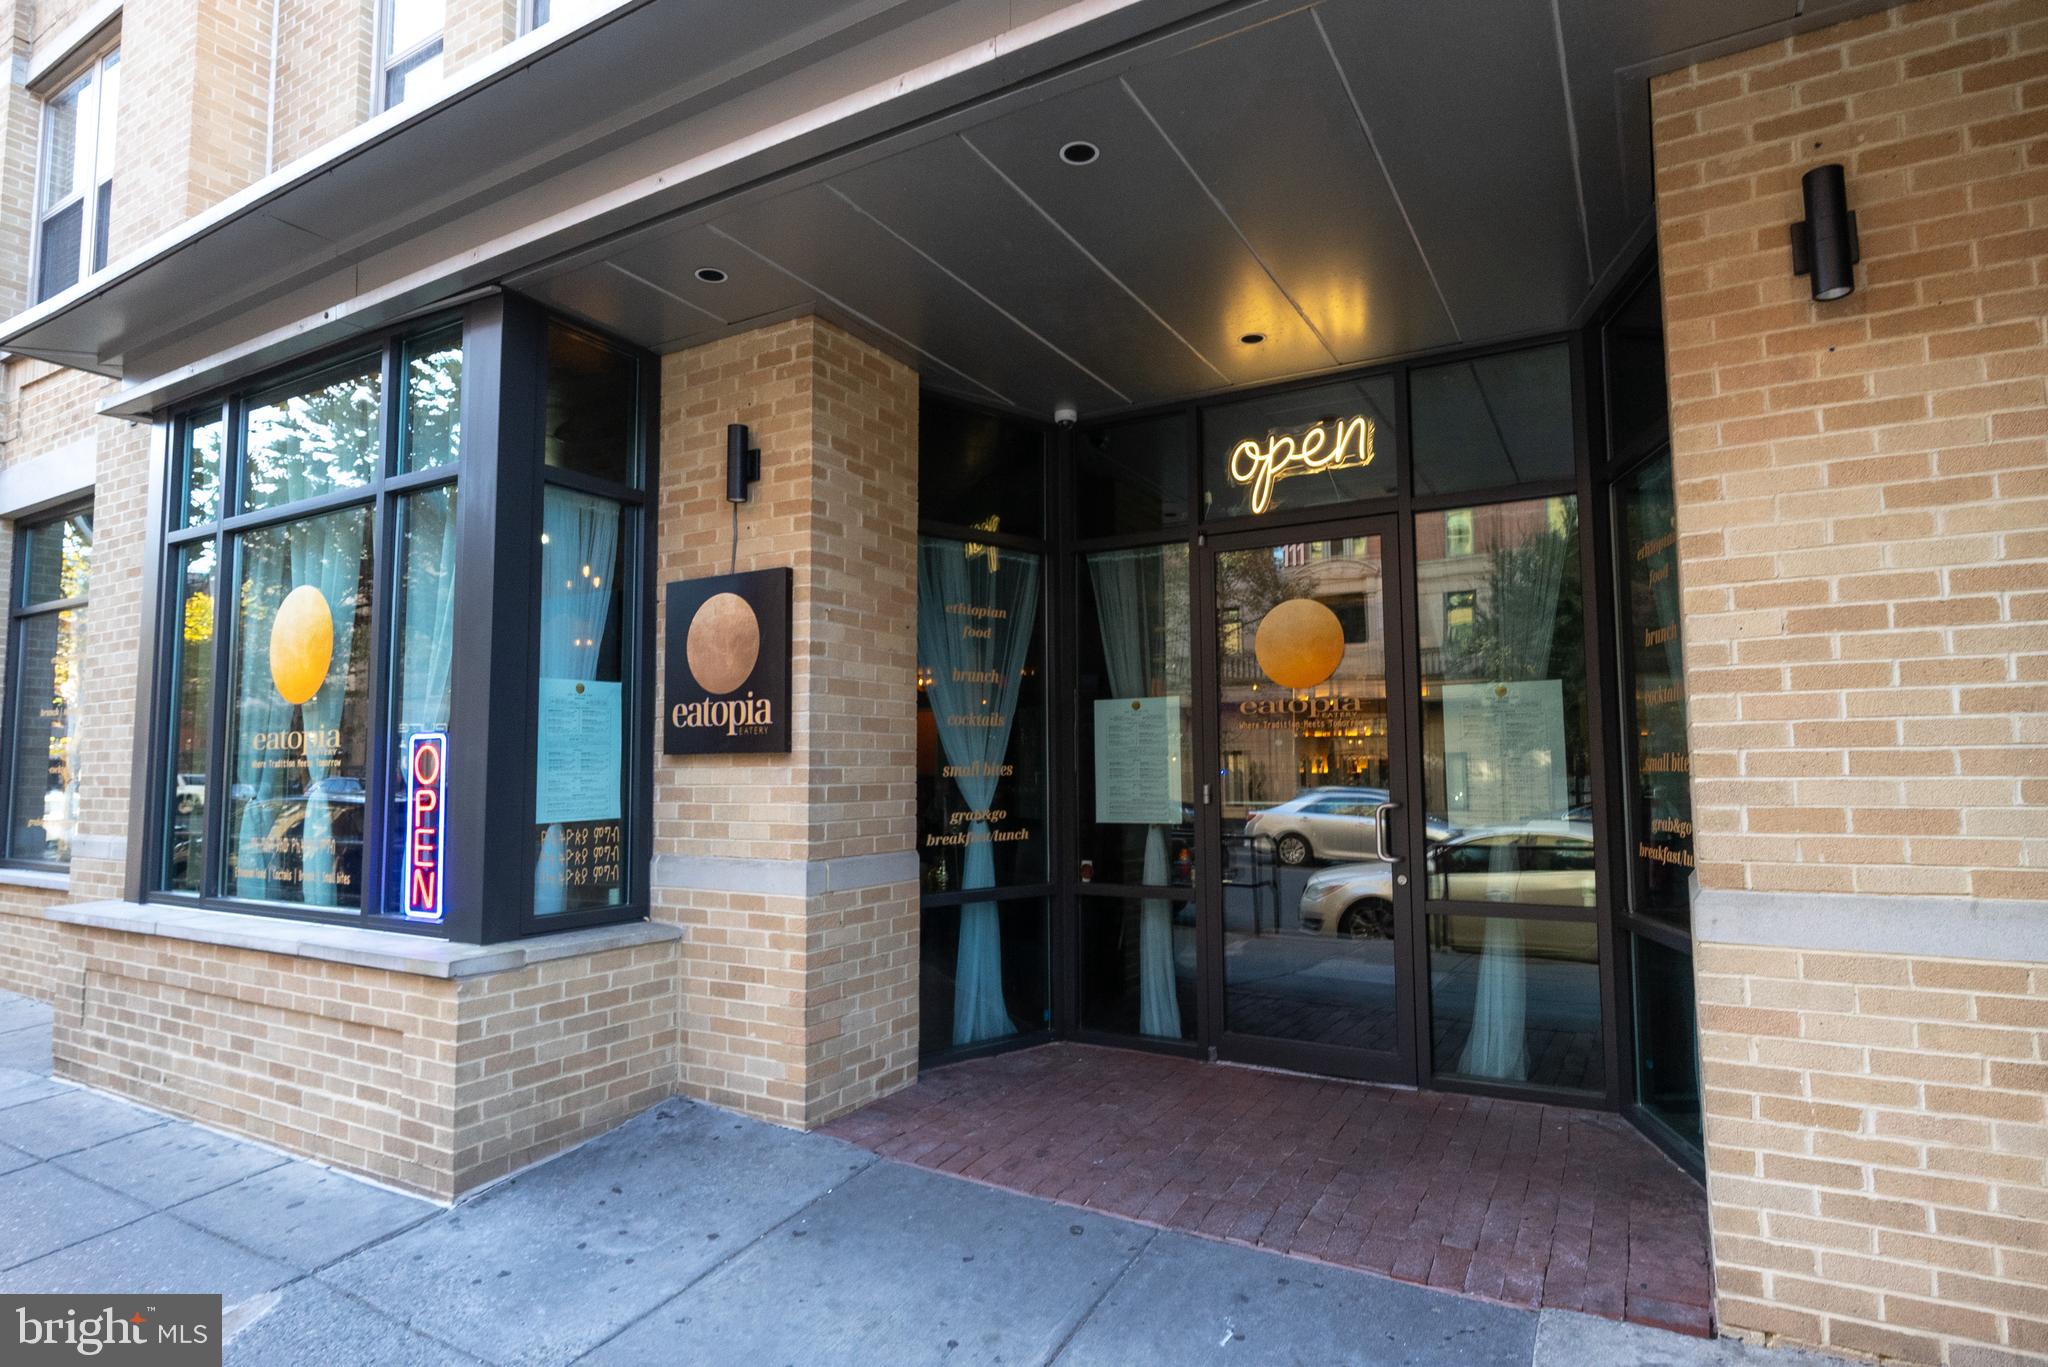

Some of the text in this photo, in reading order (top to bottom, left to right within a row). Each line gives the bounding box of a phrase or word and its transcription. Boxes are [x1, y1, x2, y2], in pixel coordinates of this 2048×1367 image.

[1232, 416, 1367, 514] open
[945, 603, 1008, 619] ethiopian
[963, 625, 992, 639] food
[1644, 624, 1677, 648] brunch
[952, 668, 1000, 684] brunch
[1644, 682, 1685, 705] cocktail
[672, 691, 773, 736] eatopia
[1240, 697, 1362, 718] eatopia
[947, 711, 1005, 727] cocktails
[252, 724, 341, 756] eatopia
[739, 726, 769, 735] EATERY
[942, 761, 1014, 778] small bites
[1643, 752, 1691, 773] small bite
[411, 744, 440, 908] OPEN
[950, 808, 1007, 825] grab&go
[1651, 816, 1692, 838] grab&go
[926, 827, 1030, 847] breakfast/lunch
[1639, 842, 1697, 868] breakfast/lu
